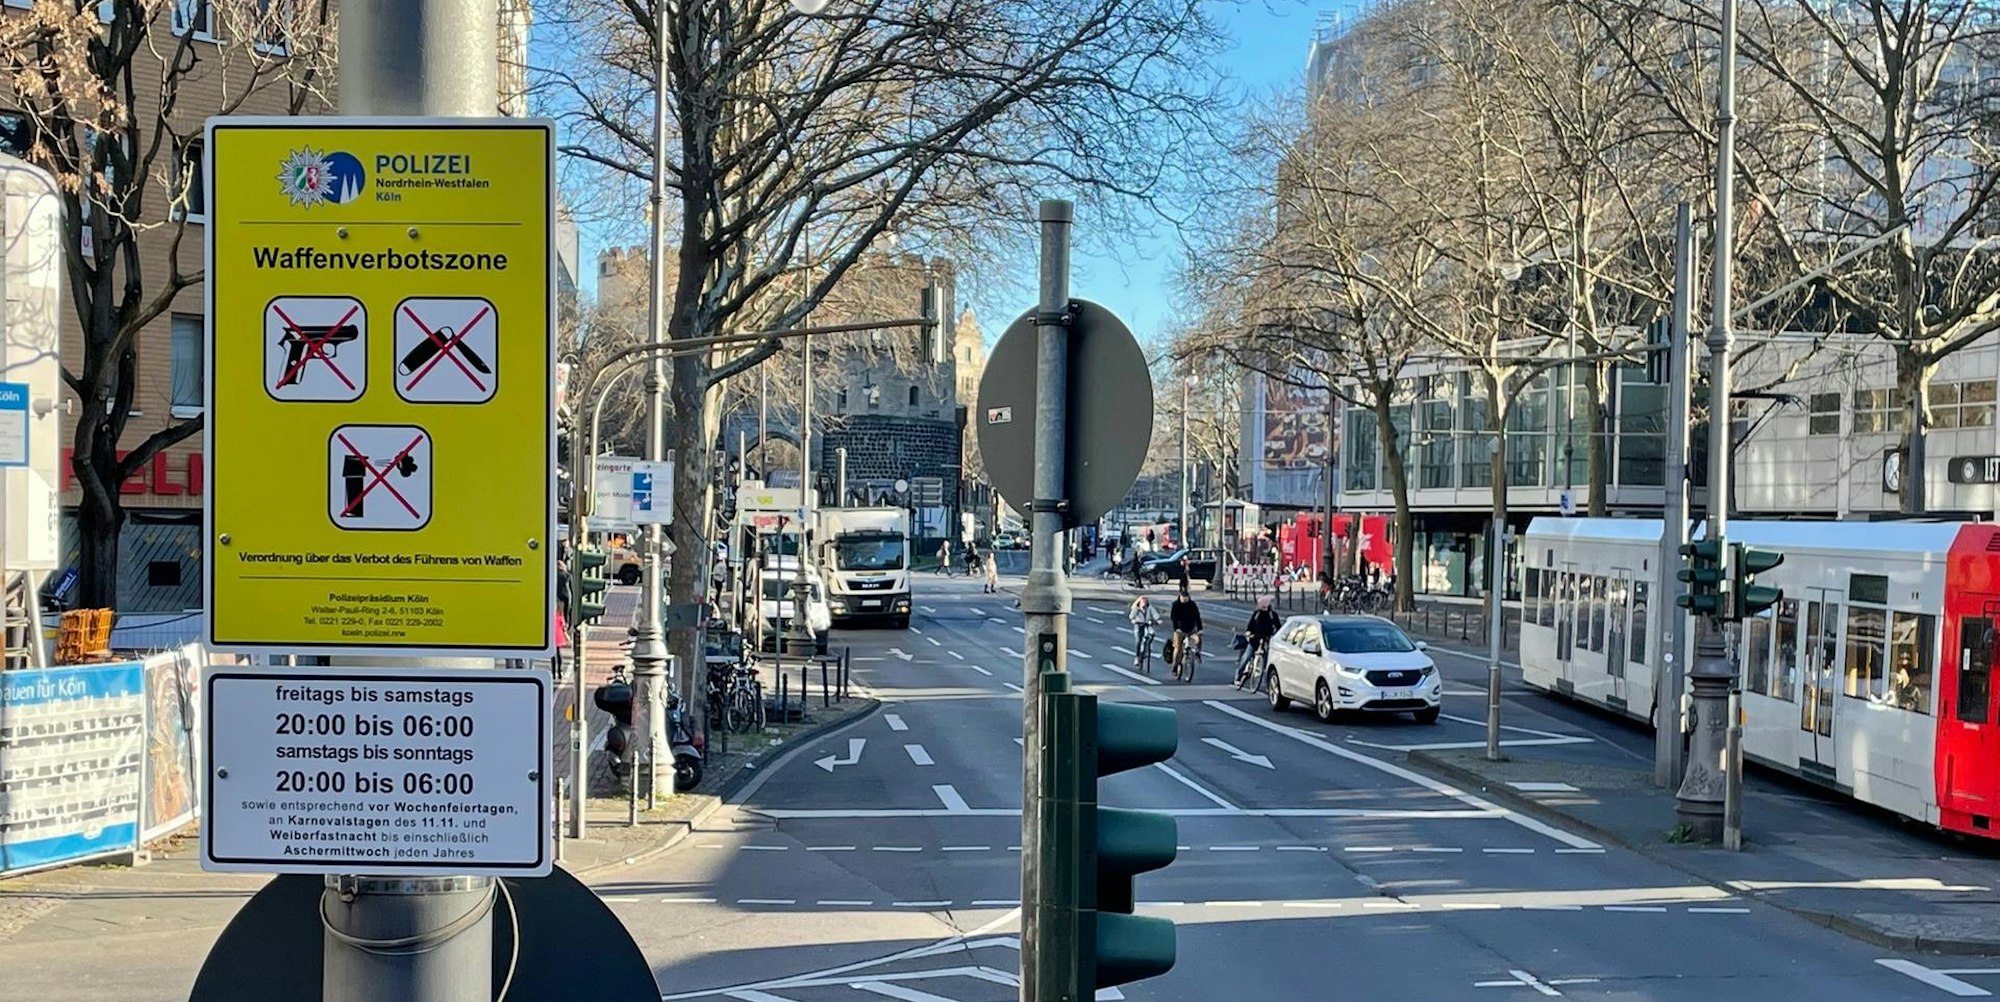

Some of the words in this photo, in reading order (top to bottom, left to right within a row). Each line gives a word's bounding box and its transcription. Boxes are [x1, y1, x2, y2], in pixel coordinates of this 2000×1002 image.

[376, 155, 470, 174] POLIZEI
[376, 178, 489, 188] Nordrhein-Westfalen
[376, 192, 401, 202] Köln
[253, 247, 508, 270] Waffenverbotszone
[239, 552, 302, 565] Verordnung
[306, 552, 330, 563] über
[332, 553, 351, 563] das
[354, 553, 390, 564] Verbot
[392, 554, 412, 564] des
[414, 554, 459, 565] Führens
[461, 556, 482, 565] von
[484, 555, 522, 566] Waffen
[329, 593, 405, 603] Polizeipräsidium
[407, 594, 429, 603] Köln
[426, 606, 444, 615] Köln
[319, 616, 338, 625] 0221
[368, 617, 383, 626] Fax
[385, 618, 403, 626] 0221
[37, 678, 57, 699] für
[58, 677, 87, 697] Köln
[276, 685, 344, 705] freitags
[351, 687, 378, 702] bis
[384, 688, 474, 707] samstags
[275, 713, 345, 736] 20:00
[355, 714, 394, 736] bis
[403, 715, 474, 737] 06:00
[276, 744, 358, 763] samstags
[363, 744, 389, 760] bis
[393, 746, 474, 765] sonntags
[275, 770, 345, 793] 20:00
[355, 771, 394, 794] bis
[403, 772, 474, 795] 06:00
[241, 800, 276, 810] sowie
[280, 800, 364, 812] entsprechend
[368, 803, 390, 811] vor
[394, 801, 519, 816] Wochenfeiertagen,
[268, 816, 283, 825] an
[288, 815, 390, 829] Karnevalstagen
[394, 817, 417, 828] des
[422, 817, 459, 828] 11.11.
[463, 818, 486, 828] und
[269, 829, 377, 841] Weiberfastnacht
[381, 832, 399, 842] bis
[403, 832, 489, 843] einschließlich
[283, 845, 390, 857] Aschermittwoch
[393, 847, 428, 859] jeden
[432, 848, 475, 858] Jahres
